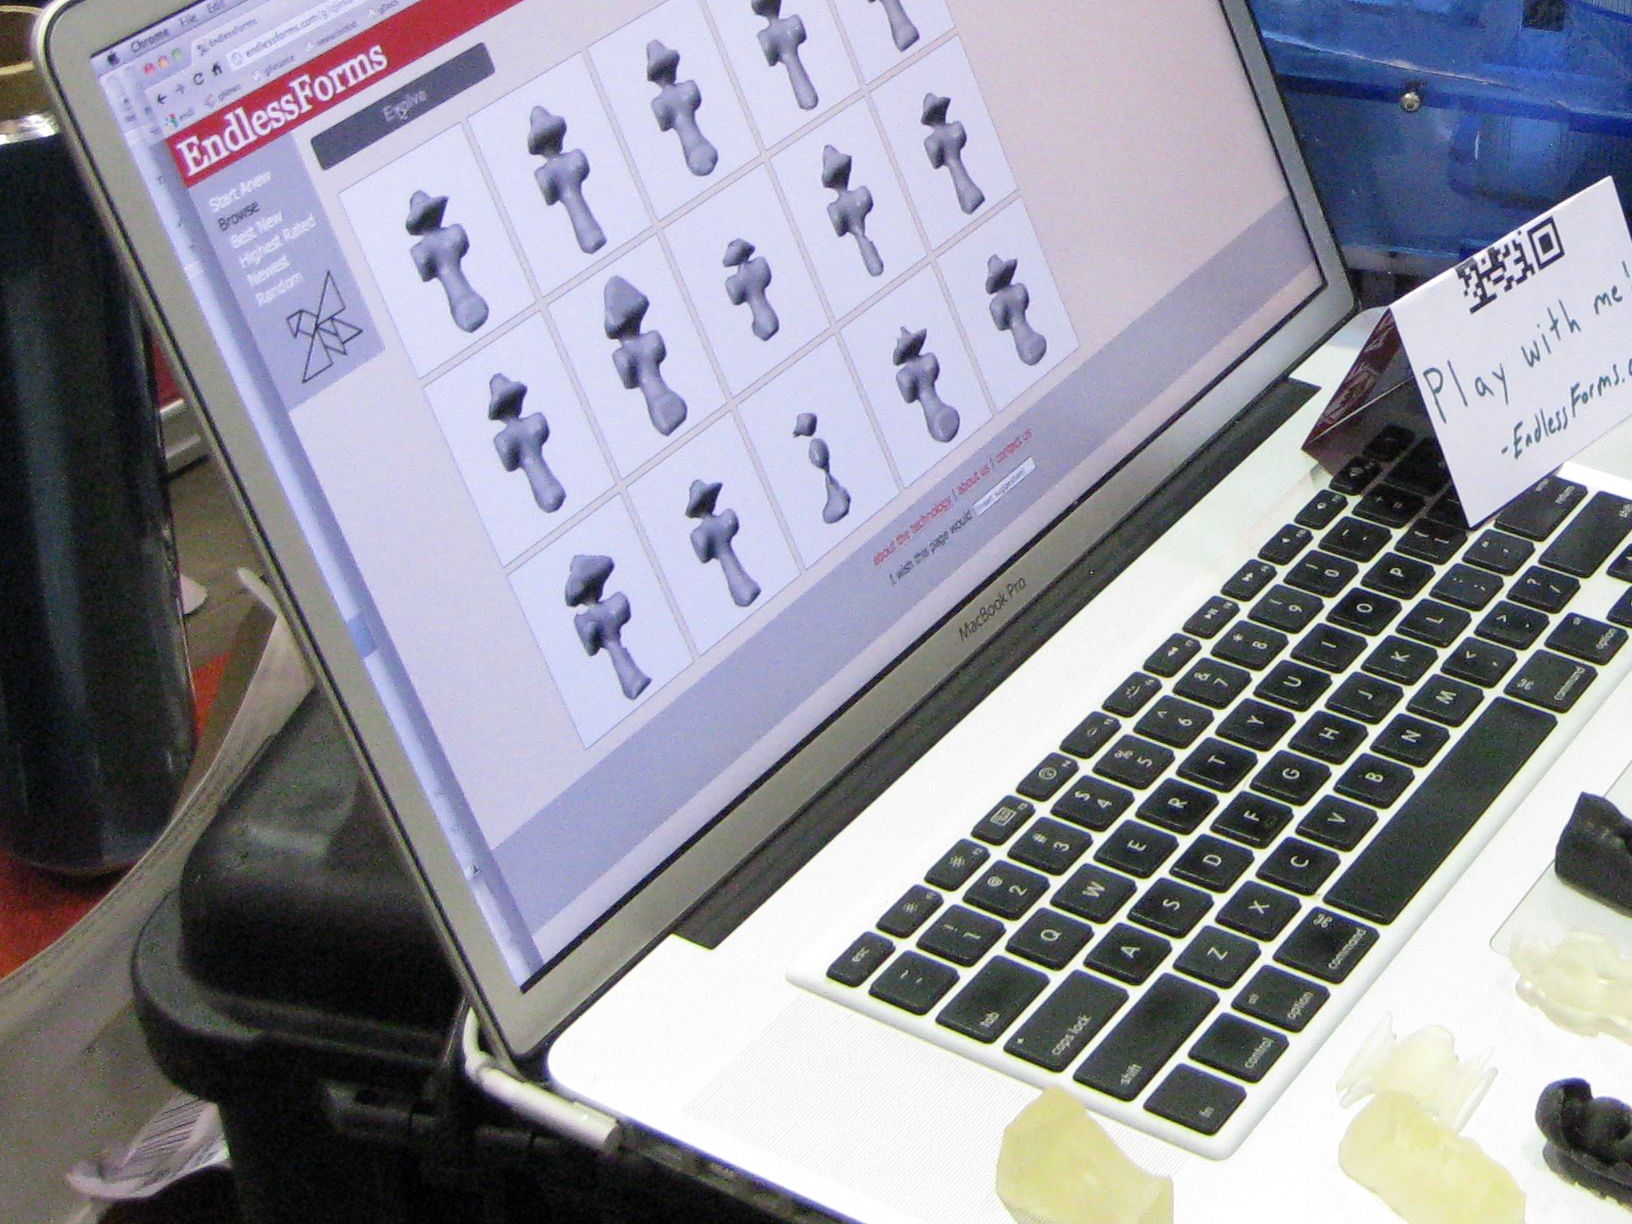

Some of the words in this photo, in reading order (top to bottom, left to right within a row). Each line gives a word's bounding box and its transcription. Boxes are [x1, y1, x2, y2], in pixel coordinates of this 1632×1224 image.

[176, 44, 388, 177] EndlessForms
[217, 201, 260, 232] Browse
[1423, 360, 1510, 425] Play
[1521, 299, 1582, 368] with
[958, 590, 1007, 645] MacBook
[1005, 575, 1028, 601] Pro
